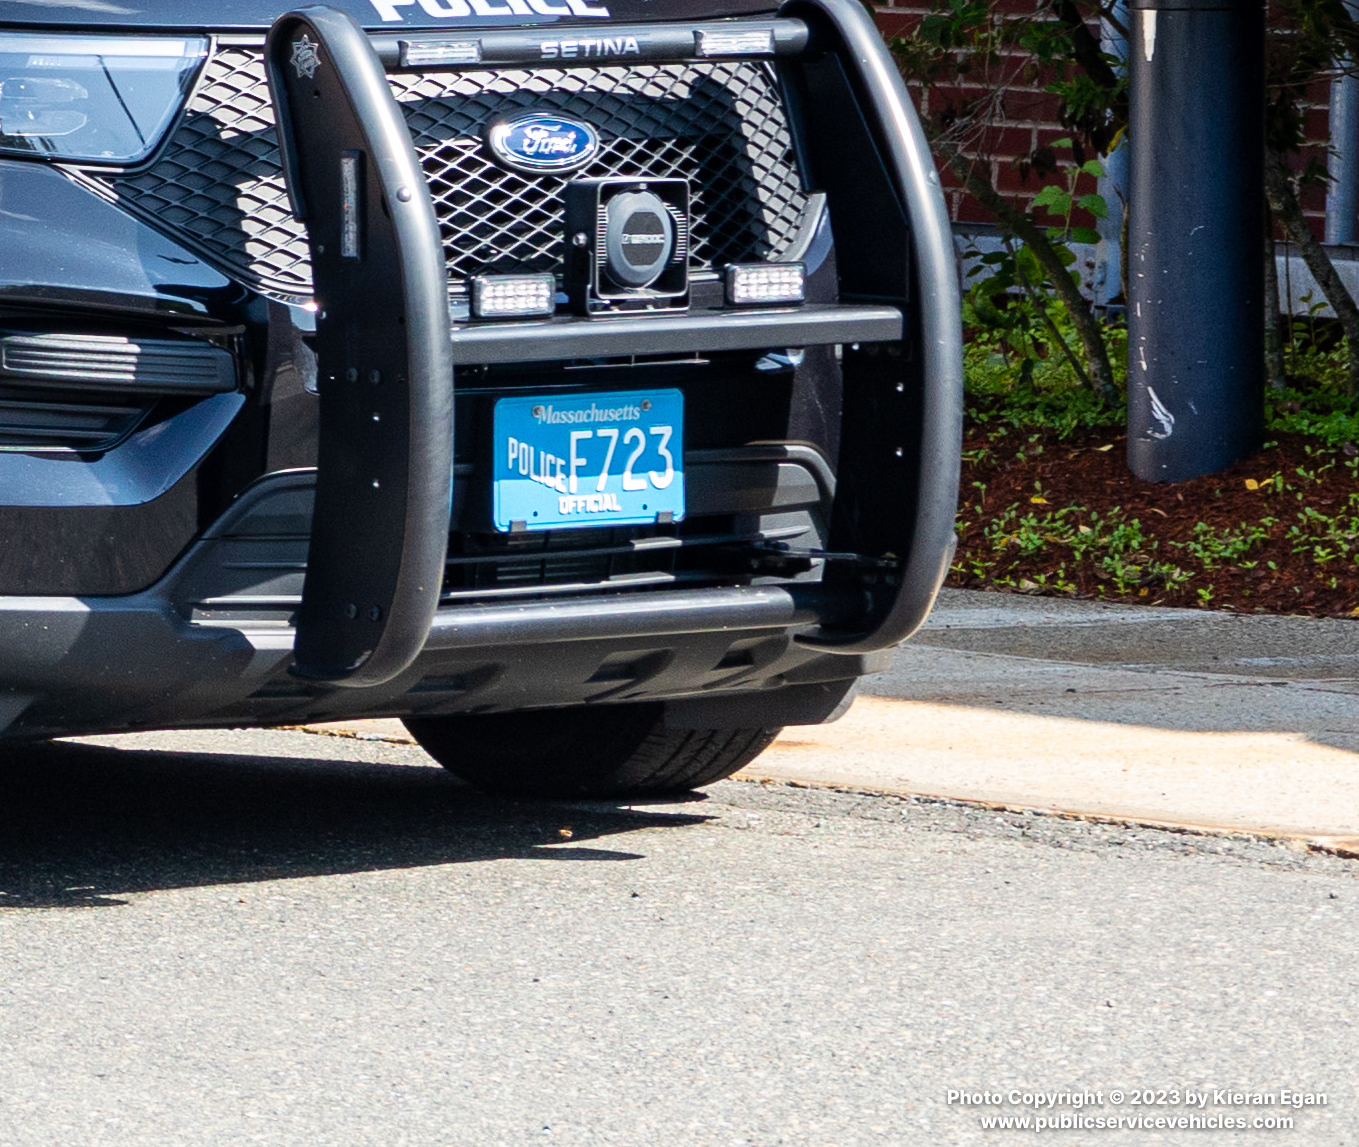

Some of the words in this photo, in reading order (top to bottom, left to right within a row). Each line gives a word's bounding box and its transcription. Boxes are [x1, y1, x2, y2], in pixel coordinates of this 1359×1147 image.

[540, 36, 640, 59] SETINA
[523, 124, 578, 155] Ford
[537, 403, 641, 424] Massachusetts
[508, 436, 567, 494] POLICE
[568, 425, 675, 494] F723
[558, 493, 622, 515] OFFICIAL
